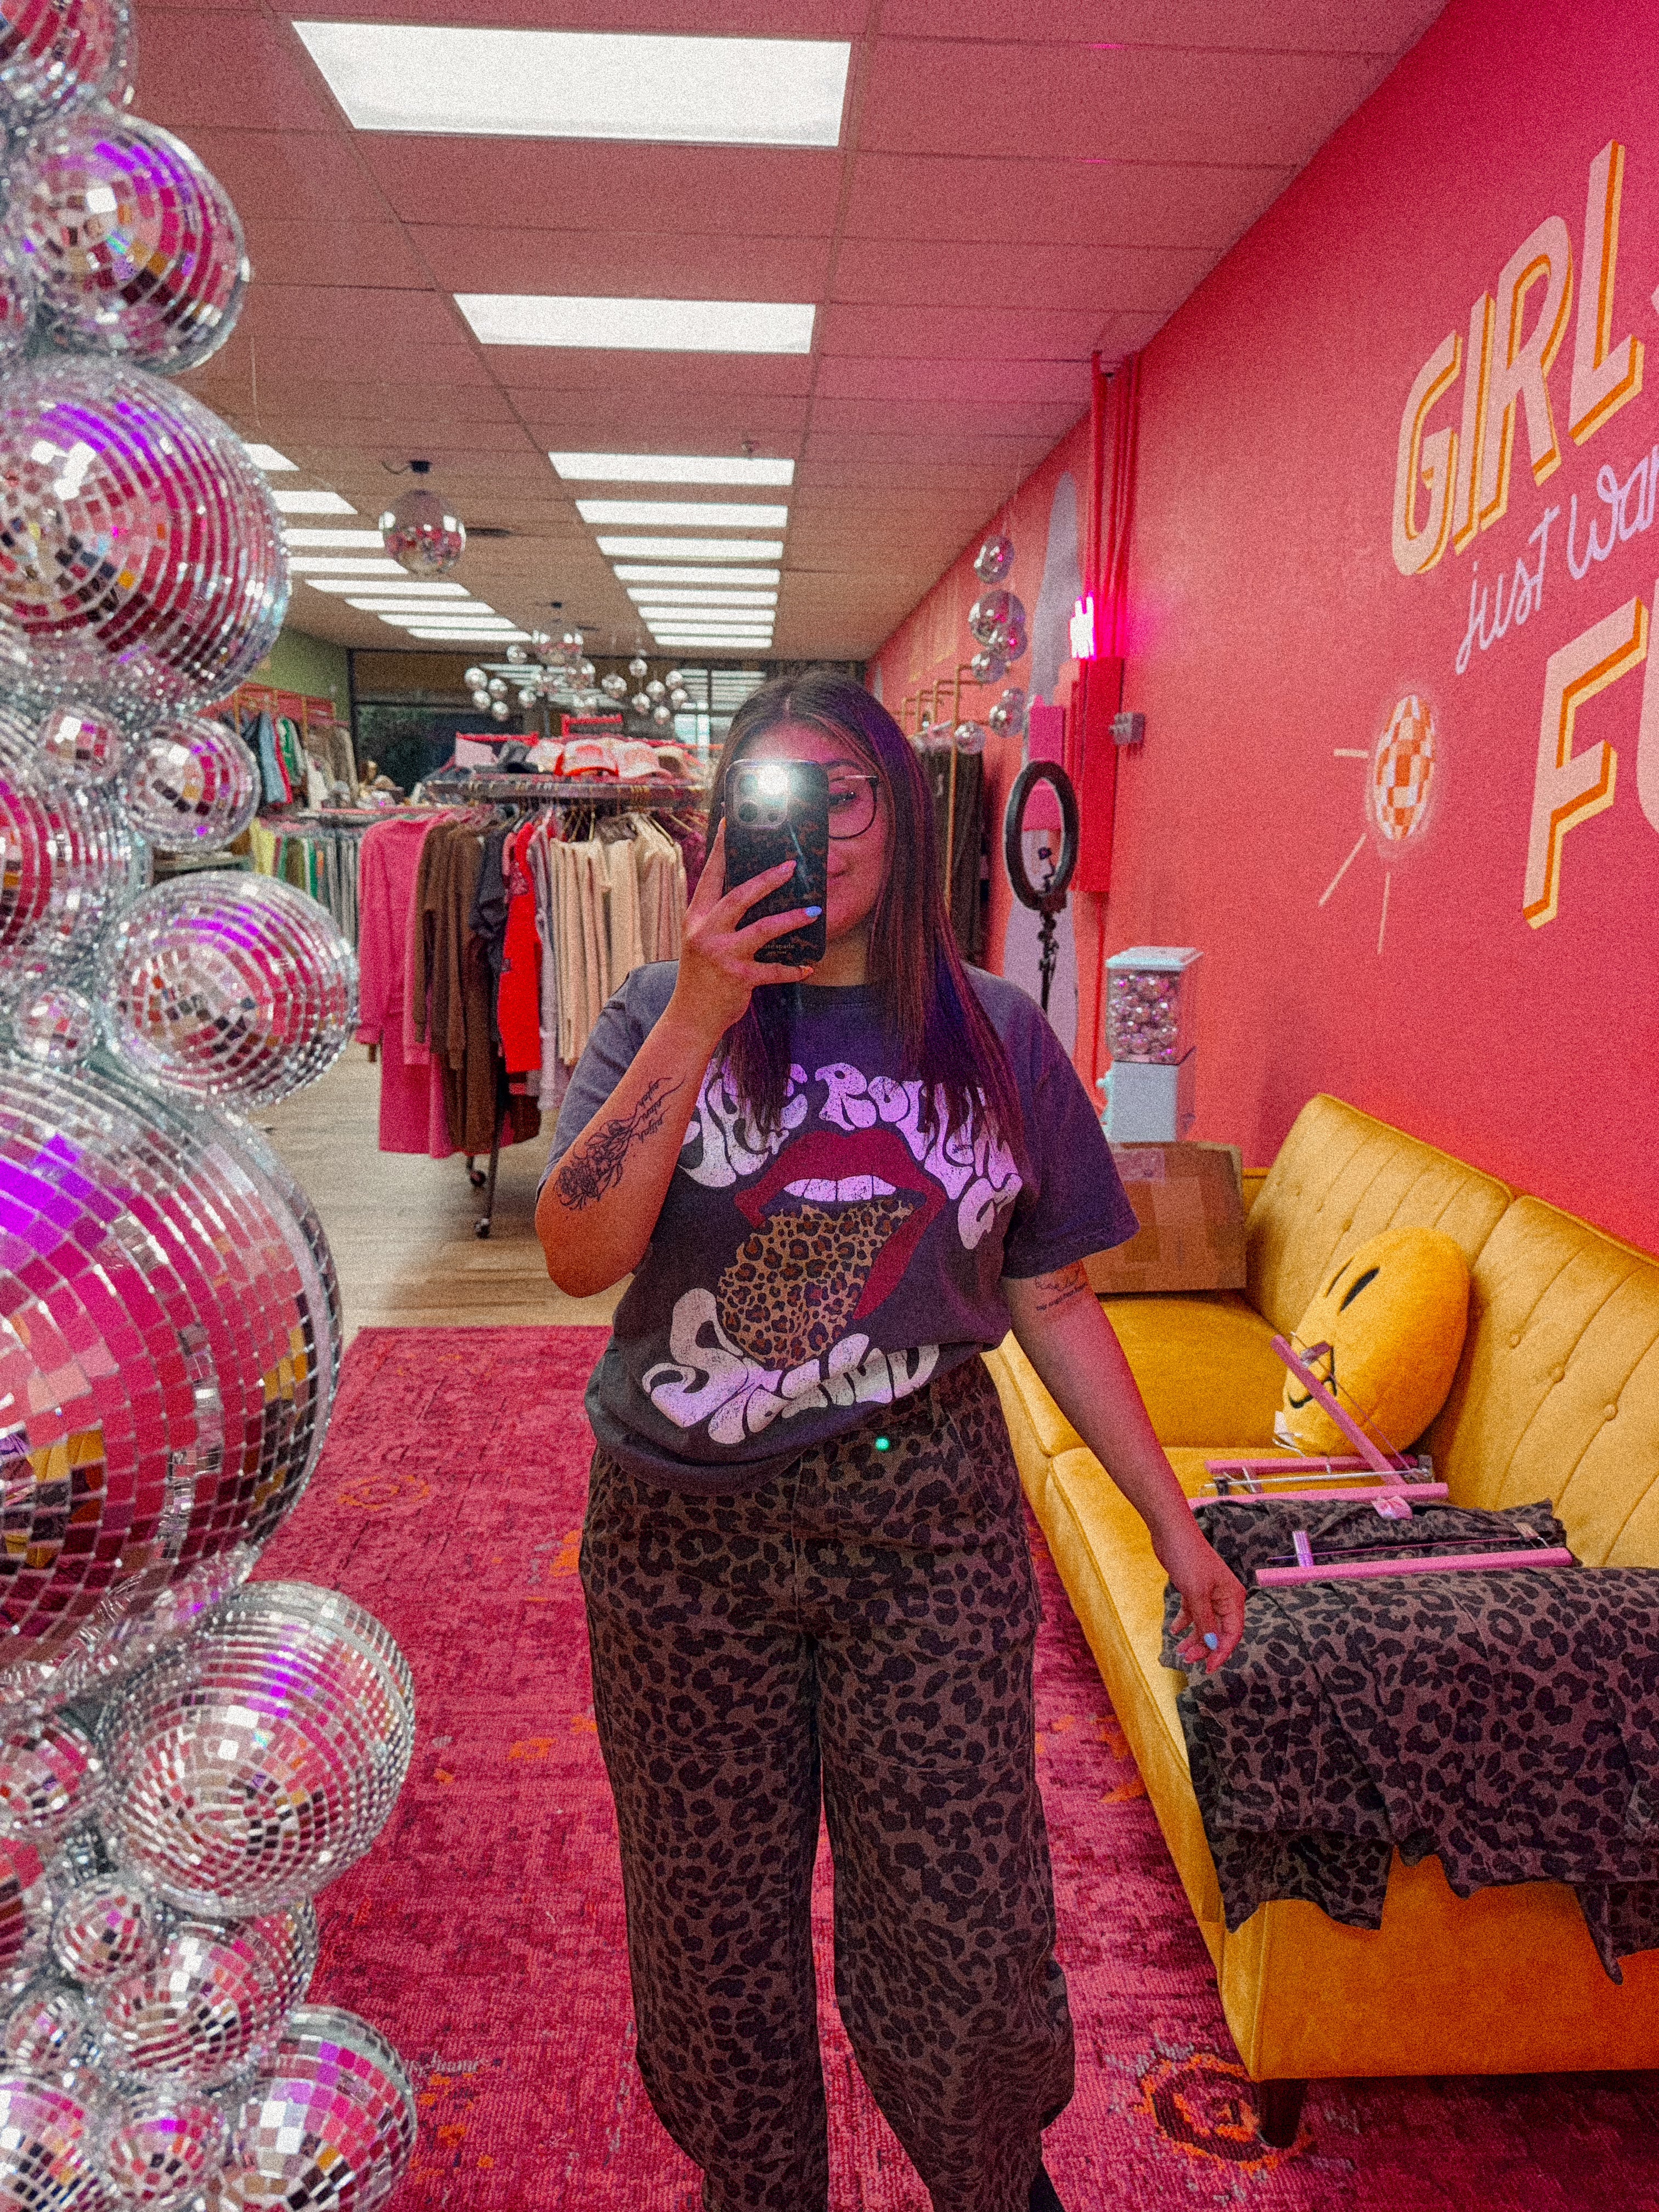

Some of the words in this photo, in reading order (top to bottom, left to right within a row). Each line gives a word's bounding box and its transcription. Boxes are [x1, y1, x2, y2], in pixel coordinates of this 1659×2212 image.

[1392, 139, 1659, 575] GIRL
[1455, 504, 1561, 675] just
[1522, 579, 1659, 930] F
[776, 943, 795, 951] spade
